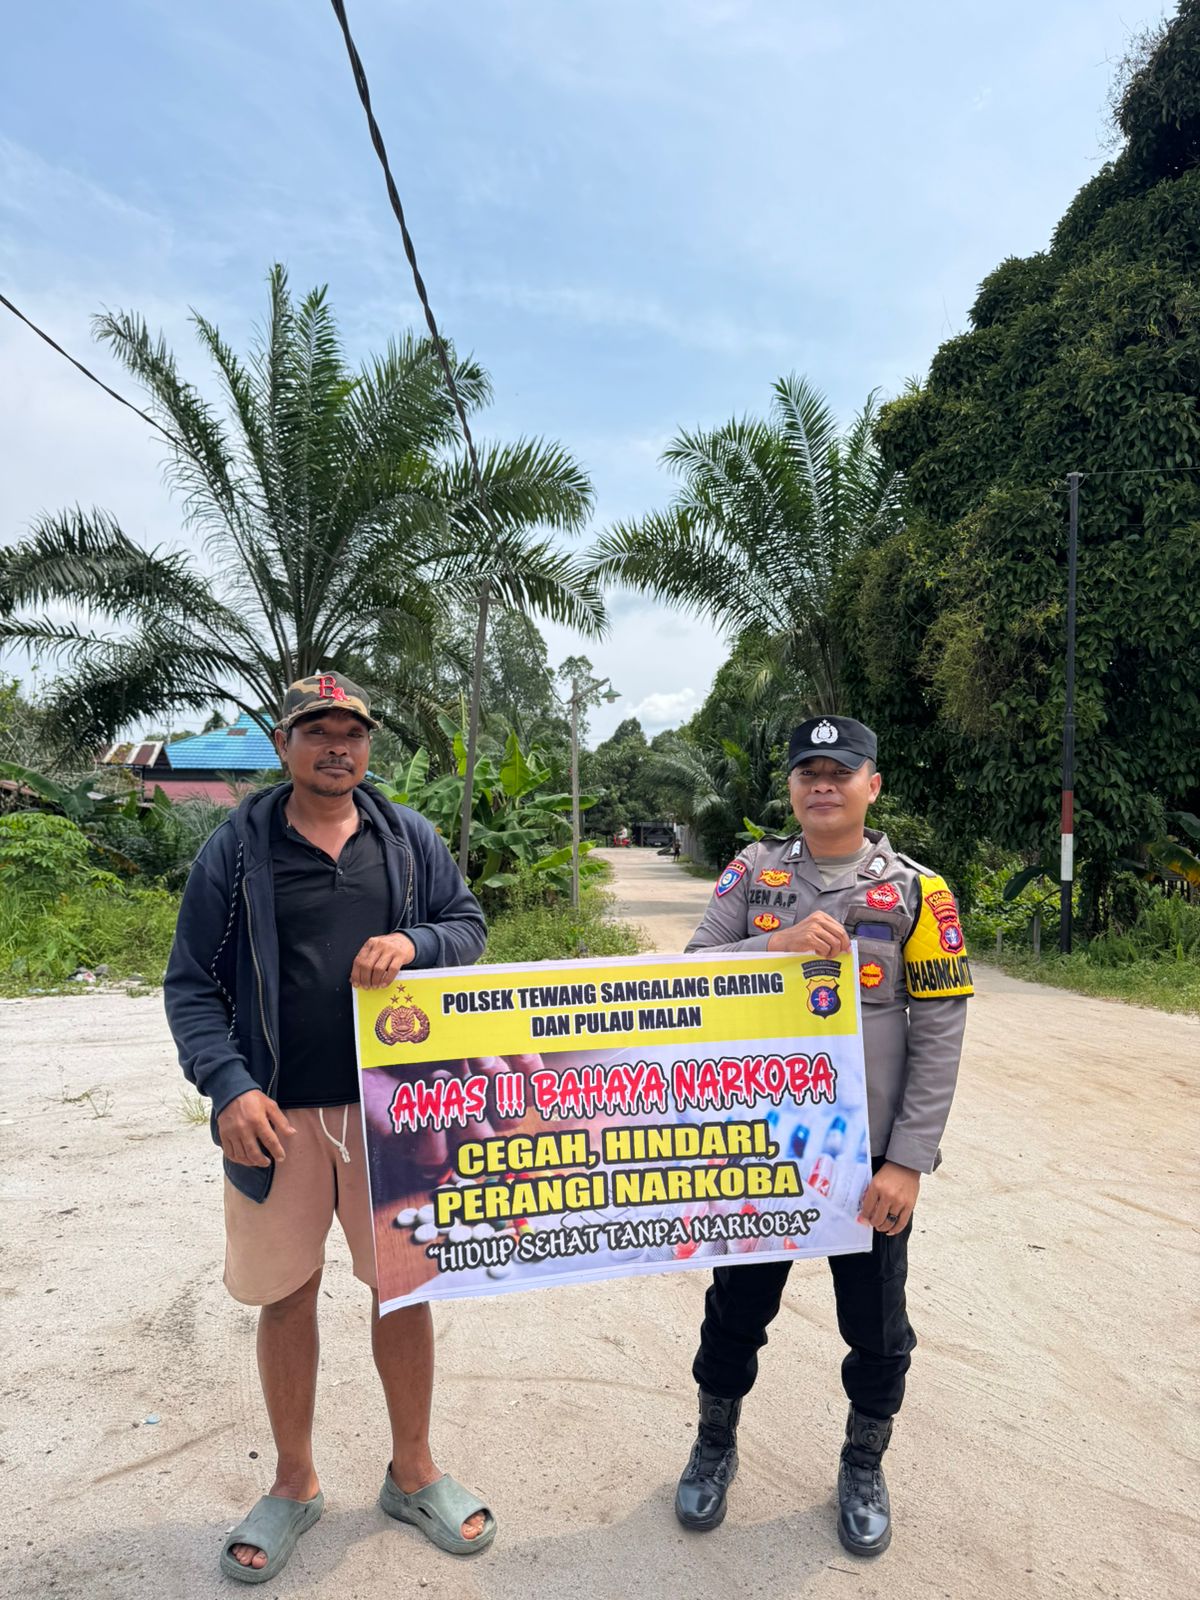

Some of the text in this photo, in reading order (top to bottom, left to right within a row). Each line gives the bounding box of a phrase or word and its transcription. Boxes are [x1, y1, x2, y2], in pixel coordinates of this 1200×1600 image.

[750, 889, 771, 905] ZEN
[443, 973, 783, 1014] POLSEK TEWANG SANGALANG GARING
[532, 1007, 701, 1038] DAN PULAU MALAN
[391, 1054, 836, 1133] AWAS !!! BAHAYA NARKOBA
[458, 1123, 777, 1176] CEGAH, HINDARI,
[437, 1166, 799, 1225] PERANGI NARKOBA
[521, 1228, 598, 1256] SEHAT
[605, 1219, 690, 1249] TANPA
